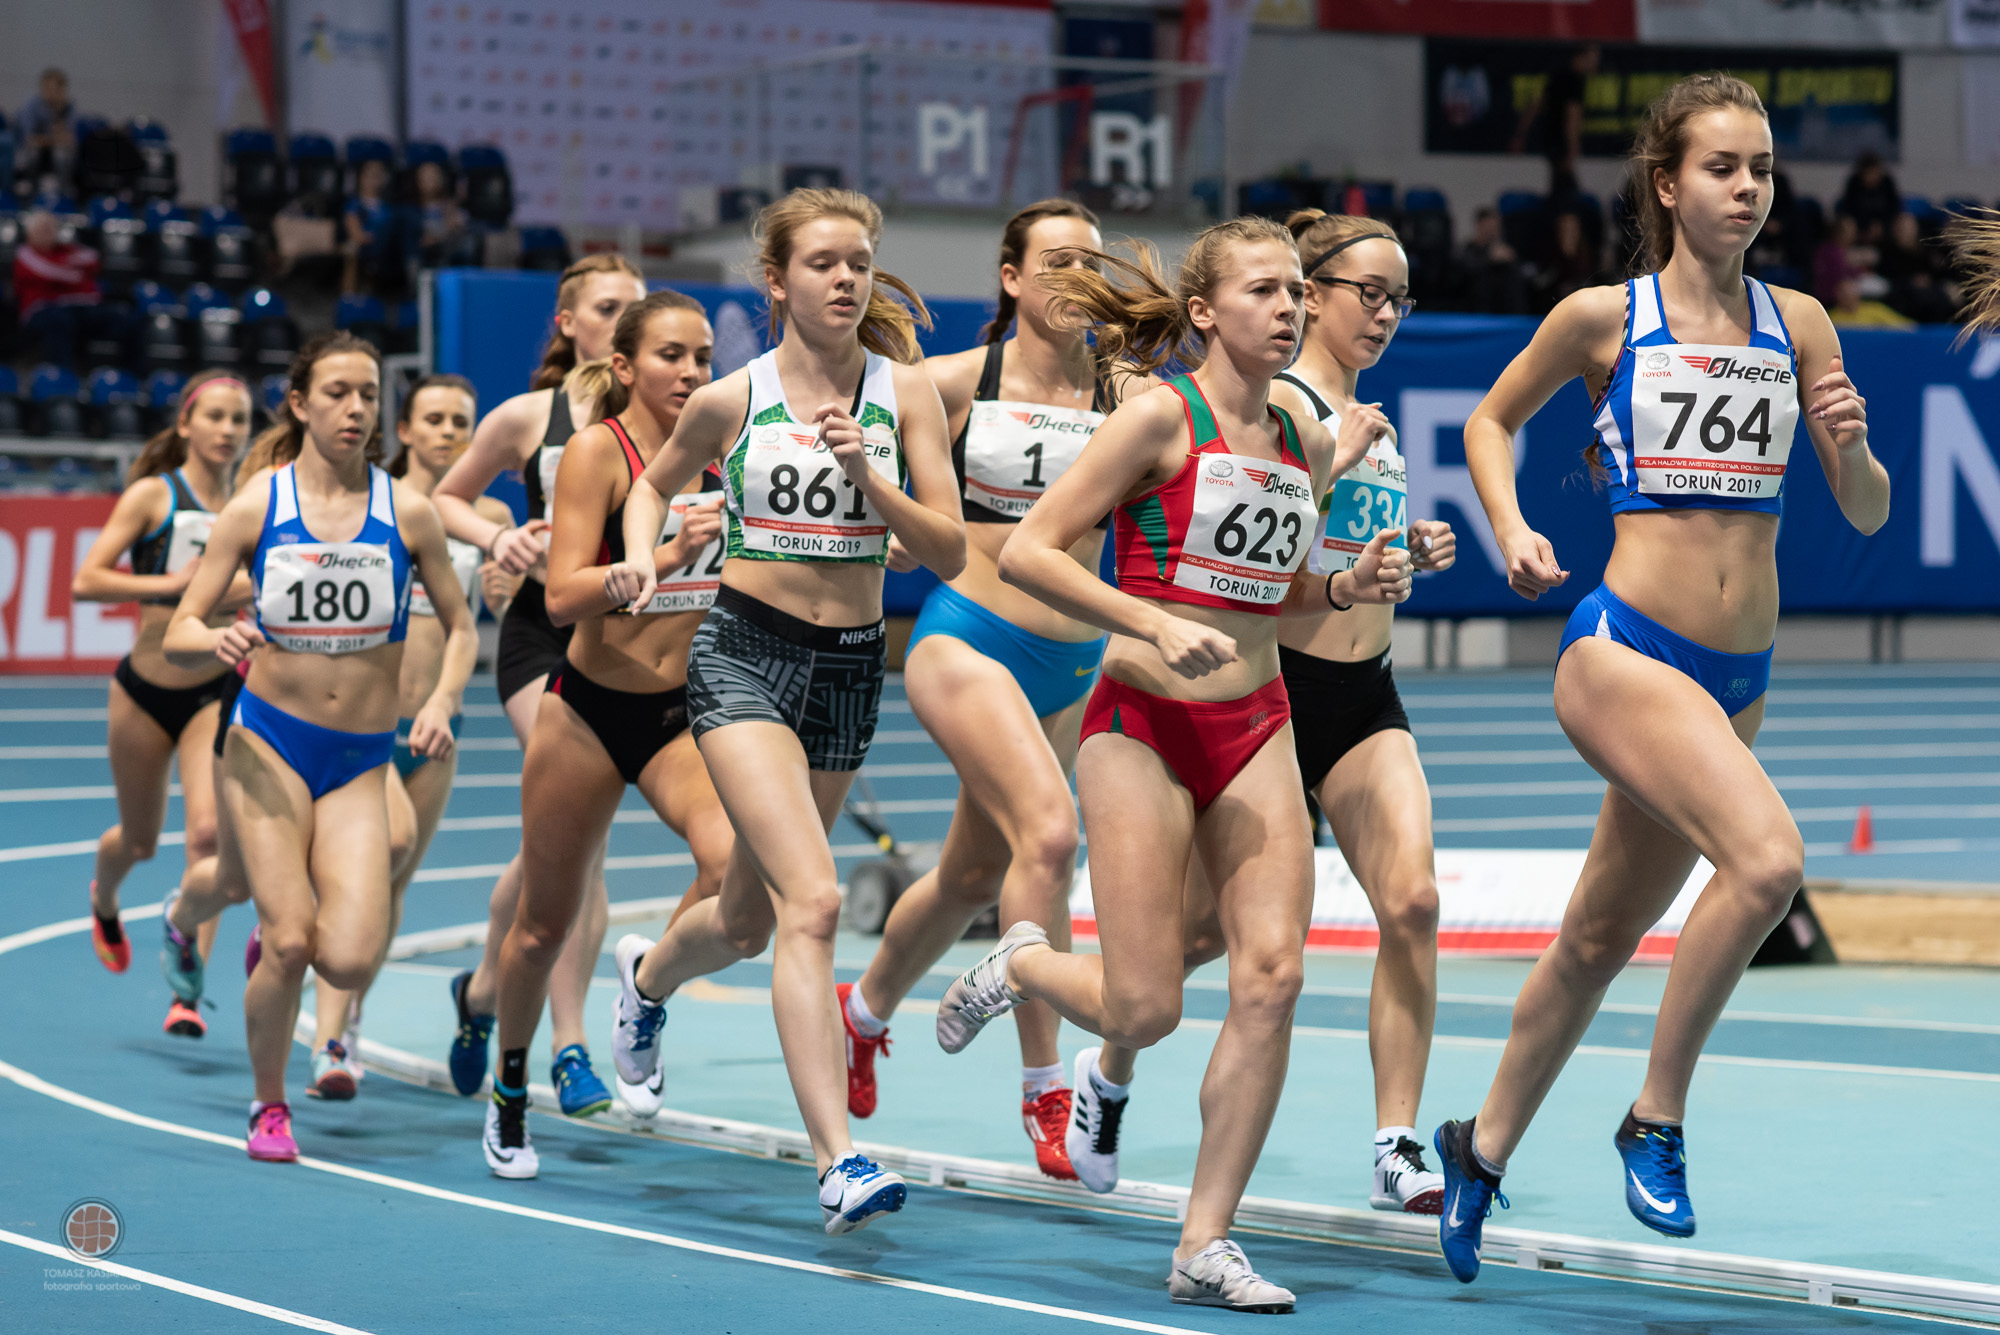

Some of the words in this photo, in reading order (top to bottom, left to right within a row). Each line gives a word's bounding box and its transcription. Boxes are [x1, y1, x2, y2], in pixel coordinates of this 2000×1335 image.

[918, 102, 989, 177] P1
[1090, 109, 1172, 187] R1
[1705, 356, 1792, 385] Okęcie
[1660, 392, 1772, 456] 764
[1022, 442, 1046, 488] 1
[1689, 461, 1739, 470] MISTRZOSTWA
[767, 463, 867, 521] 861
[1205, 477, 1234, 487] TOYOTA
[1262, 472, 1310, 501] Okęcie
[1665, 472, 1722, 491] TORUŃ
[1727, 478, 1762, 493] 2019
[1347, 485, 1408, 547] 334
[772, 534, 823, 551] TORUŃ
[828, 540, 861, 554] 2019
[1214, 503, 1302, 567] 623
[1186, 556, 1204, 565] PZLA
[1205, 560, 1235, 572] HALOWE
[286, 579, 370, 622] 180
[1210, 575, 1260, 598] TORUŃ
[1262, 586, 1281, 601] 2019
[336, 638, 366, 650] 2019
[839, 628, 877, 645] NIKE
